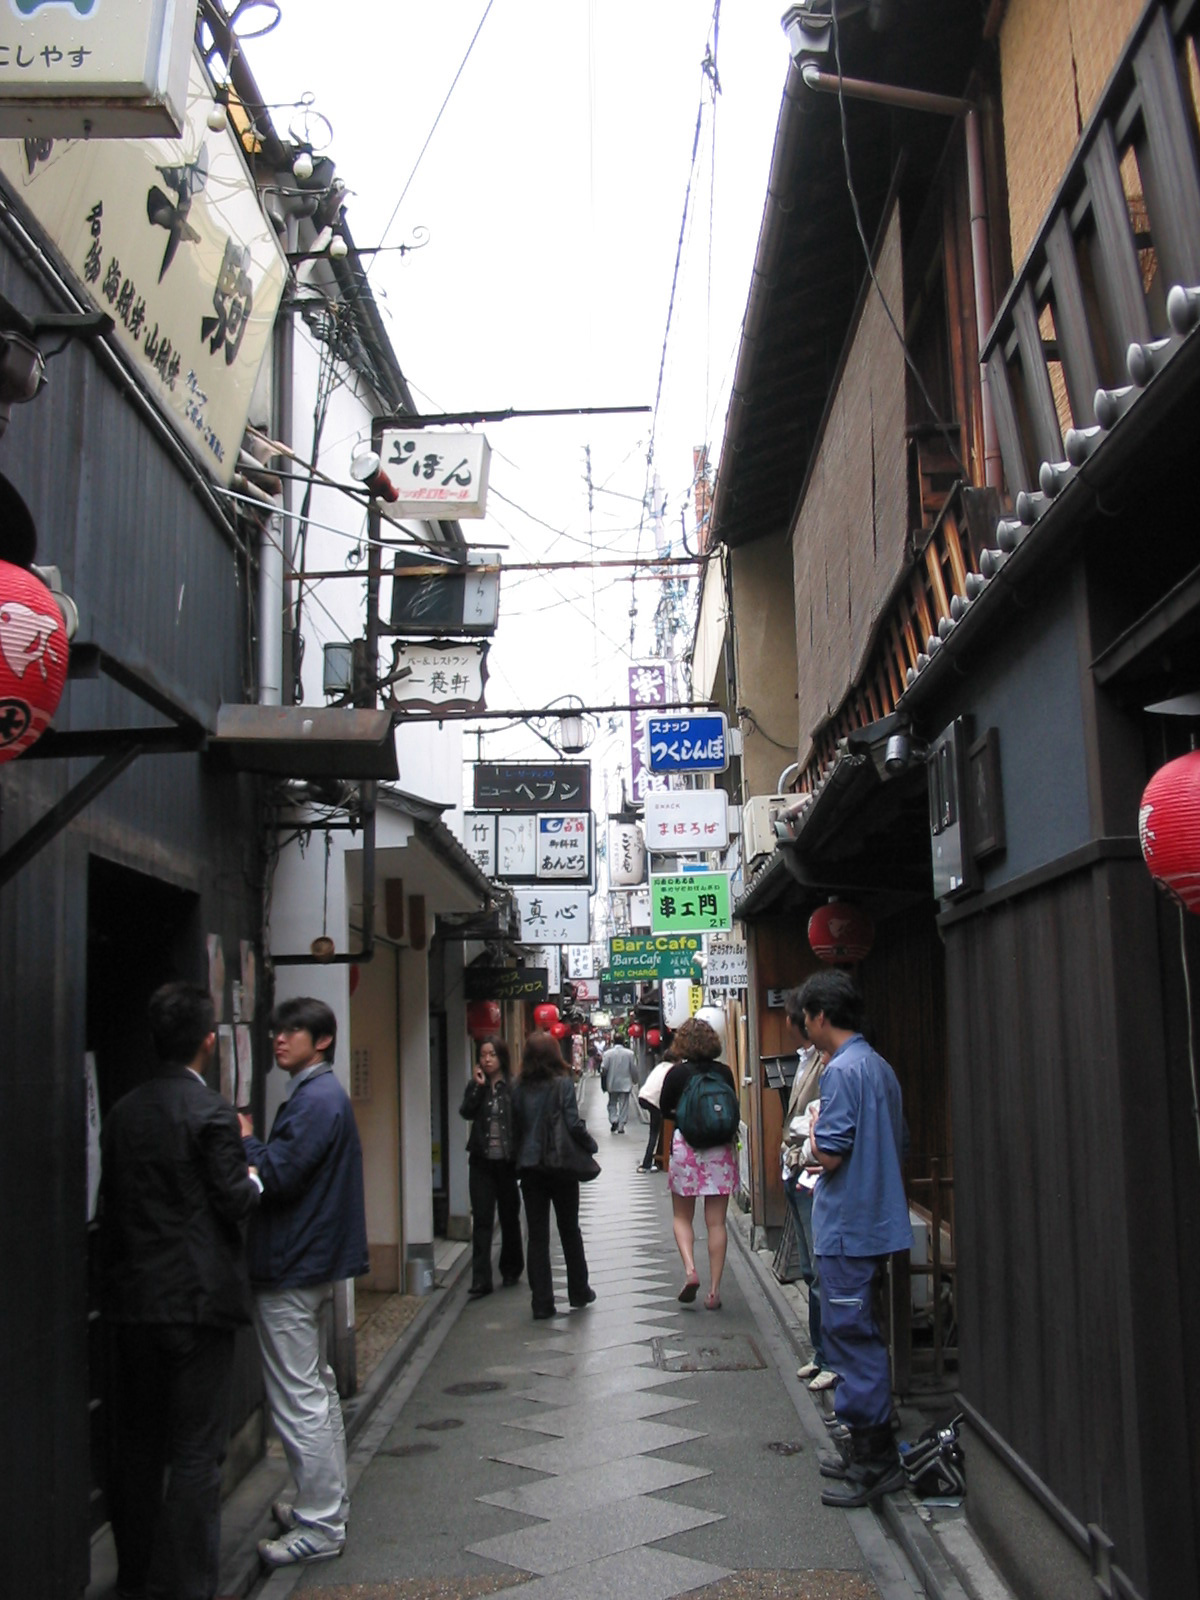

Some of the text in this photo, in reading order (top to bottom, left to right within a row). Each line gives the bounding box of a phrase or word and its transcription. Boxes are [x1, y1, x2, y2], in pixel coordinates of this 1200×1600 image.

[400, 487, 470, 500] ッポロビール
[651, 721, 690, 734] スナック
[651, 735, 724, 762] つくしんぼ
[658, 821, 720, 836] まほろば
[542, 854, 586, 871] あんどう
[524, 899, 578, 926] 真心
[613, 970, 626, 978] NO
[627, 968, 658, 977] CHARGE
